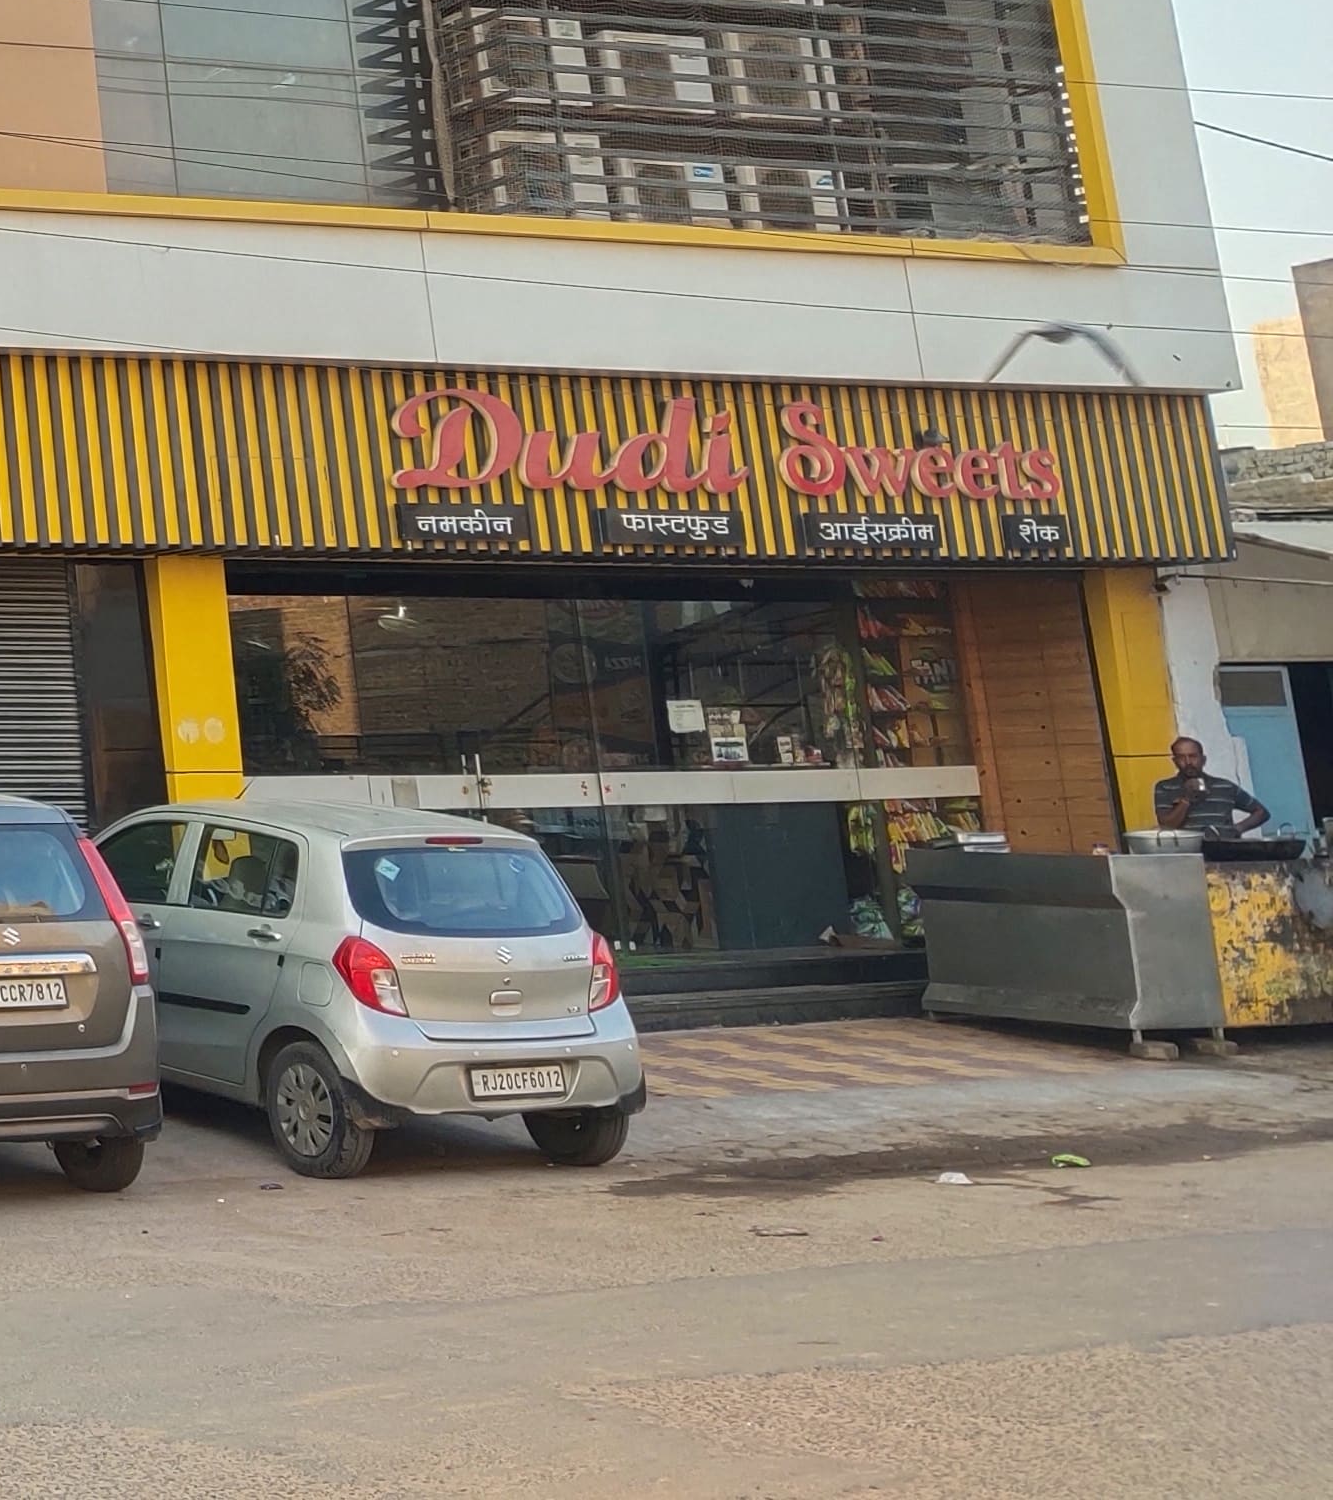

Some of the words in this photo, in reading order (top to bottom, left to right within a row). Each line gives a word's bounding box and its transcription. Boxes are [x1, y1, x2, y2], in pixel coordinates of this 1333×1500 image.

[391, 387, 749, 495] Dudi
[779, 400, 1063, 501] Sweets
[416, 509, 514, 536] नमकीन
[819, 519, 935, 546] आईसक्रीम
[1018, 521, 1061, 546] शेक
[482, 1070, 561, 1092] RJ20CF6012
